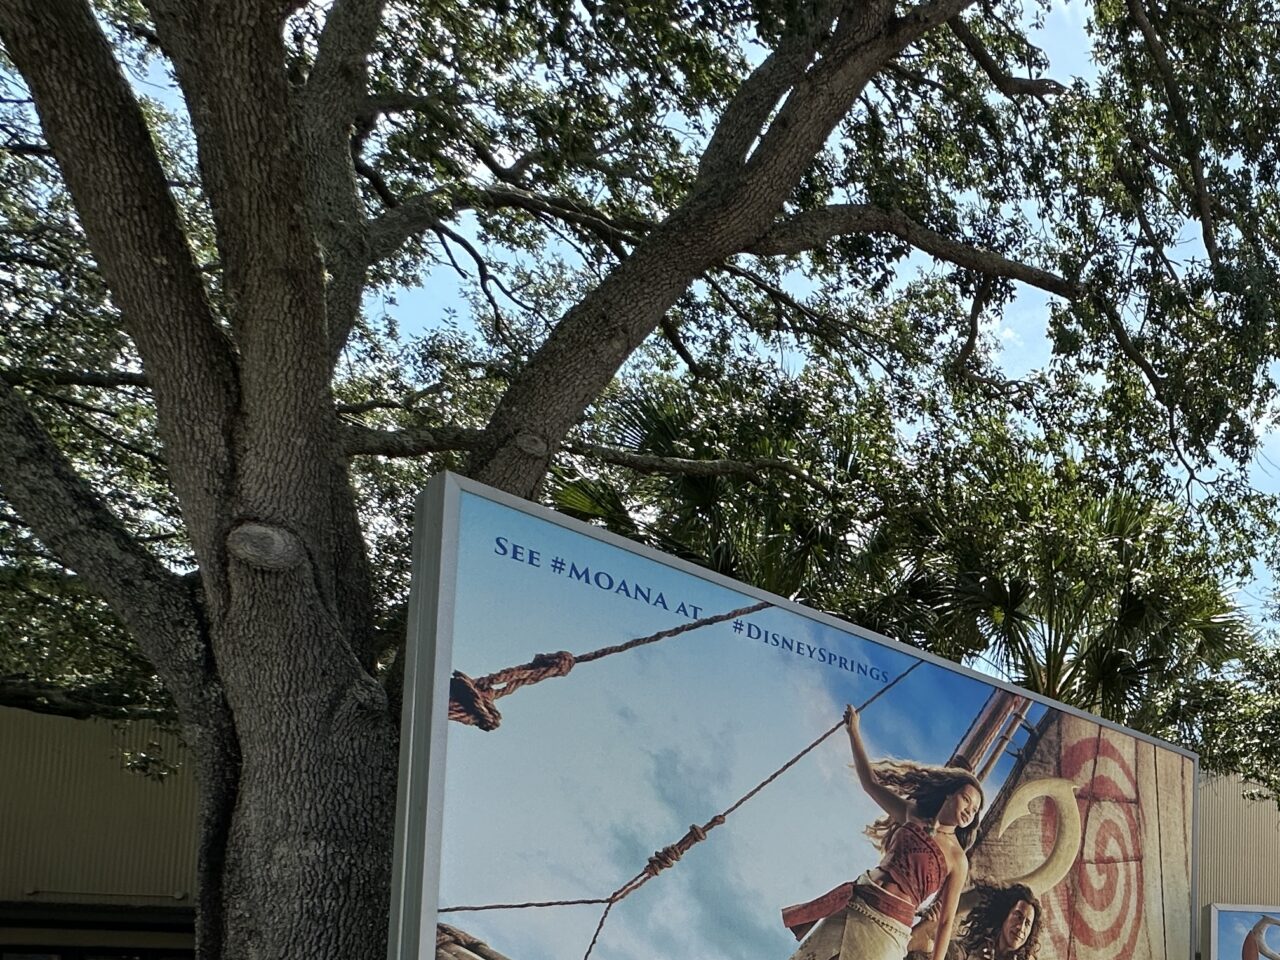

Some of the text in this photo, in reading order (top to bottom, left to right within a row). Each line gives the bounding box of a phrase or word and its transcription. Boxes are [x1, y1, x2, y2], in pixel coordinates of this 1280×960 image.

[494, 536, 889, 683] SEE #MOANA AT #DISNEYSPRINGS
